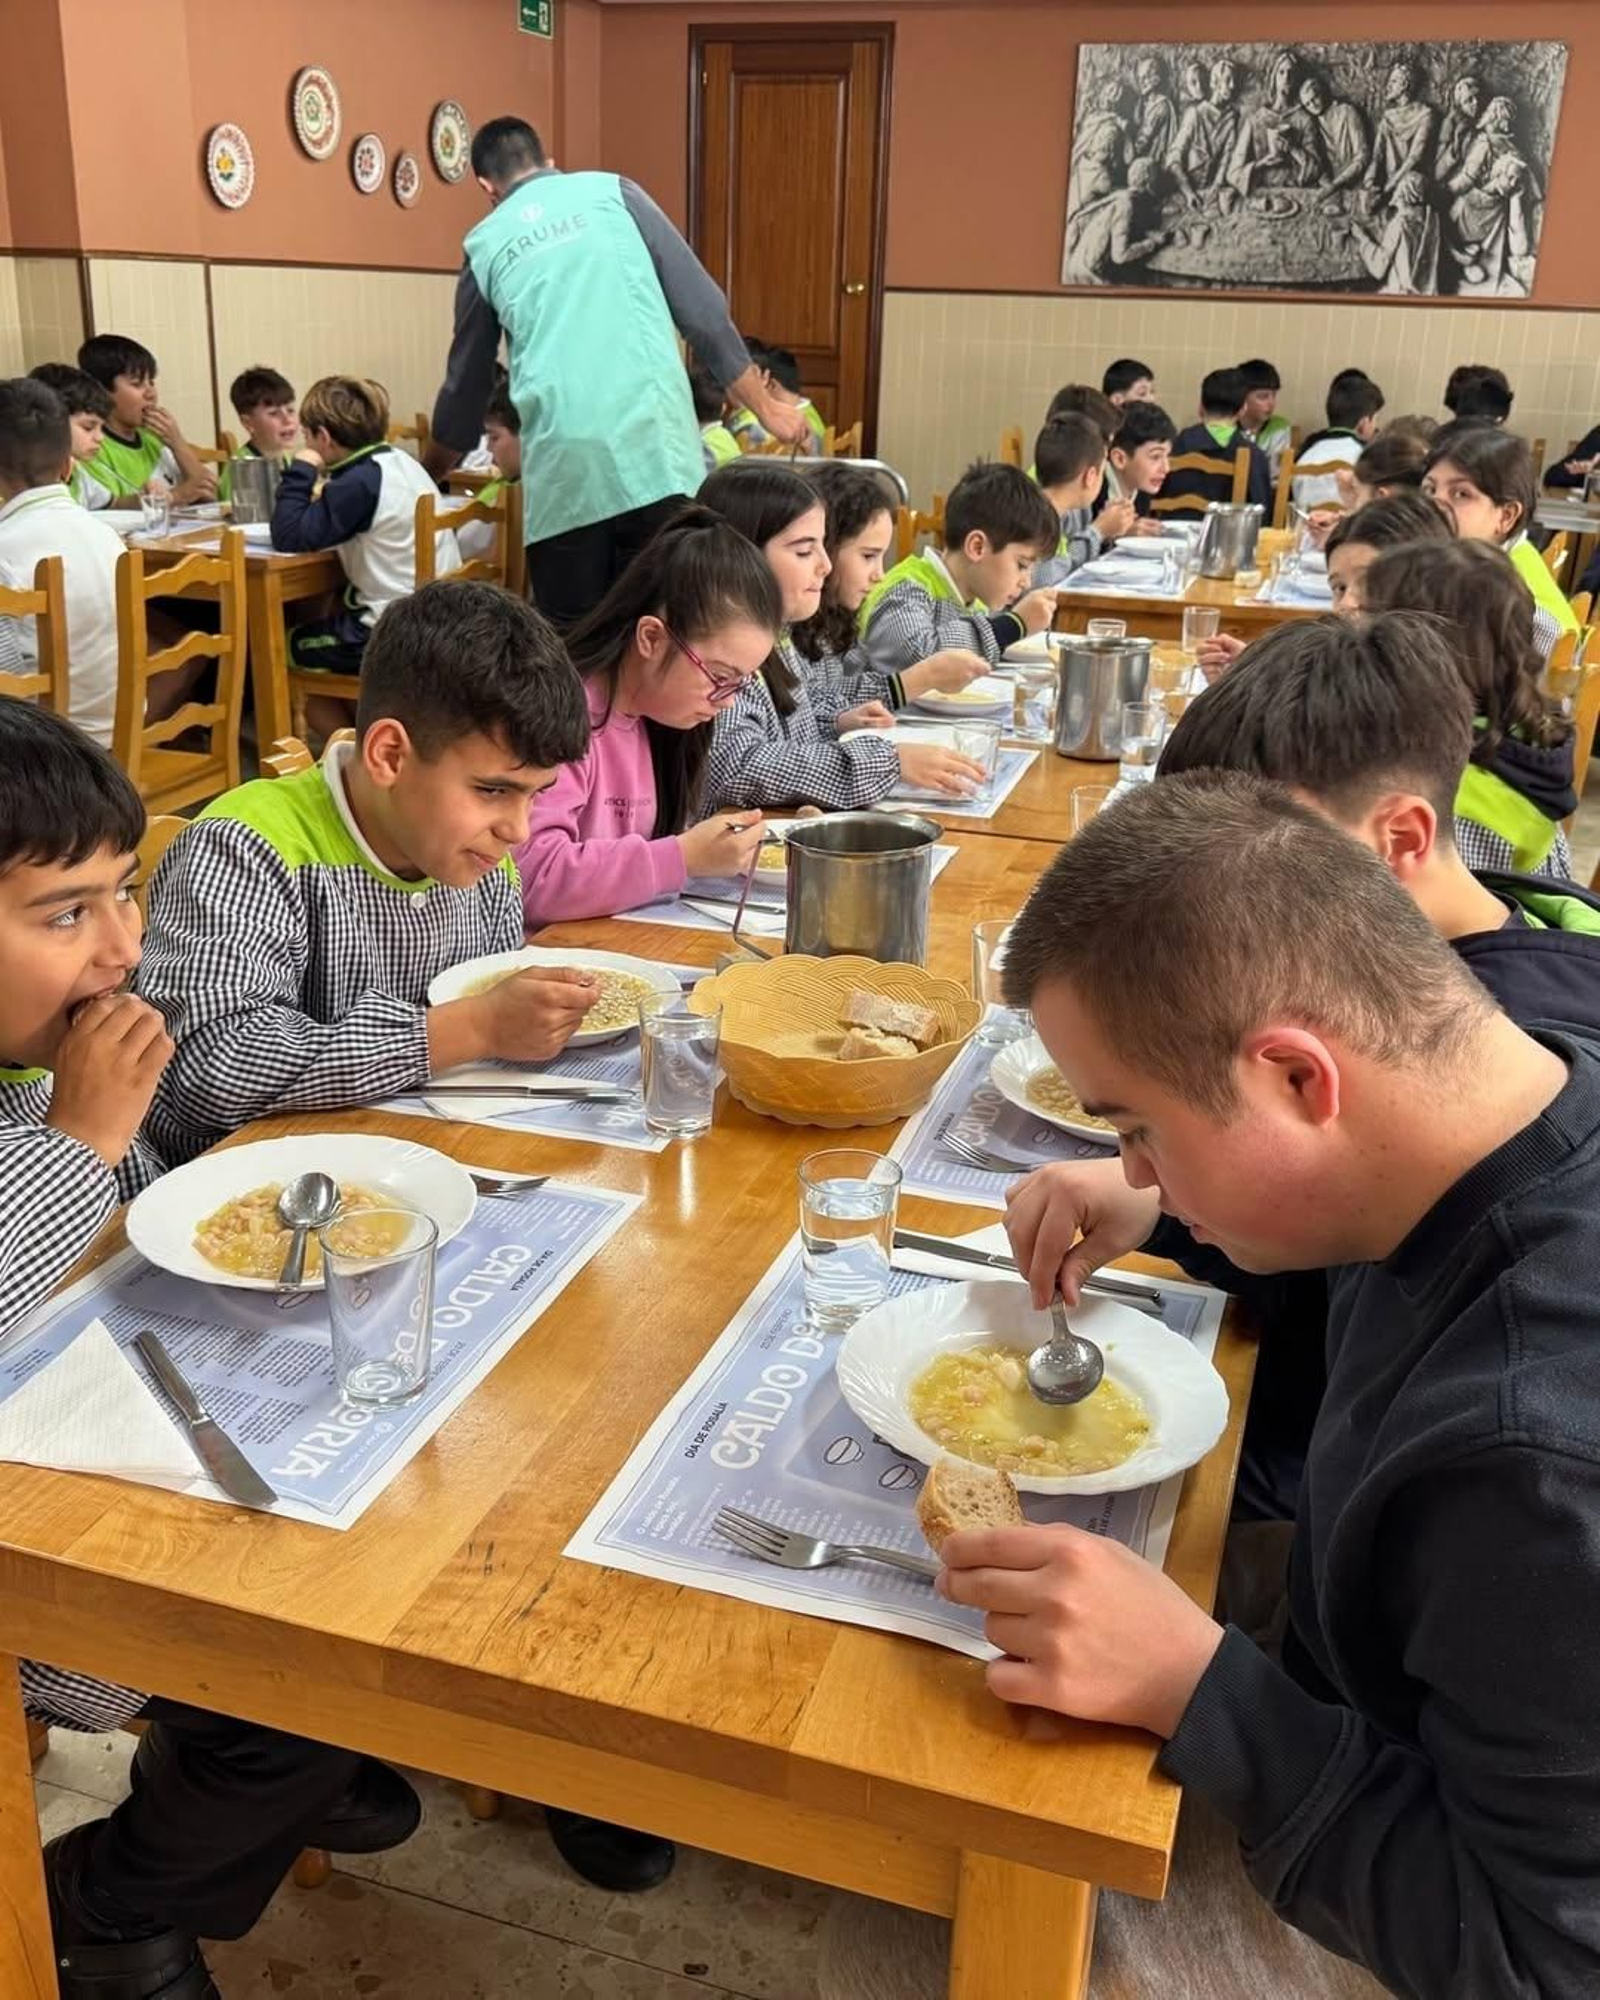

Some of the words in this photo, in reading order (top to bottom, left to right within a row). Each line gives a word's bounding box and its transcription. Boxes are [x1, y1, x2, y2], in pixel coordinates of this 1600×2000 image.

[506, 213, 588, 265] ARUME
[433, 1244, 532, 1328] CALDO
[684, 1442, 699, 1459] DÍA
[694, 1430, 708, 1446] DE
[701, 1401, 728, 1432] ROSALÍA
[710, 1363, 808, 1469] CALDO
